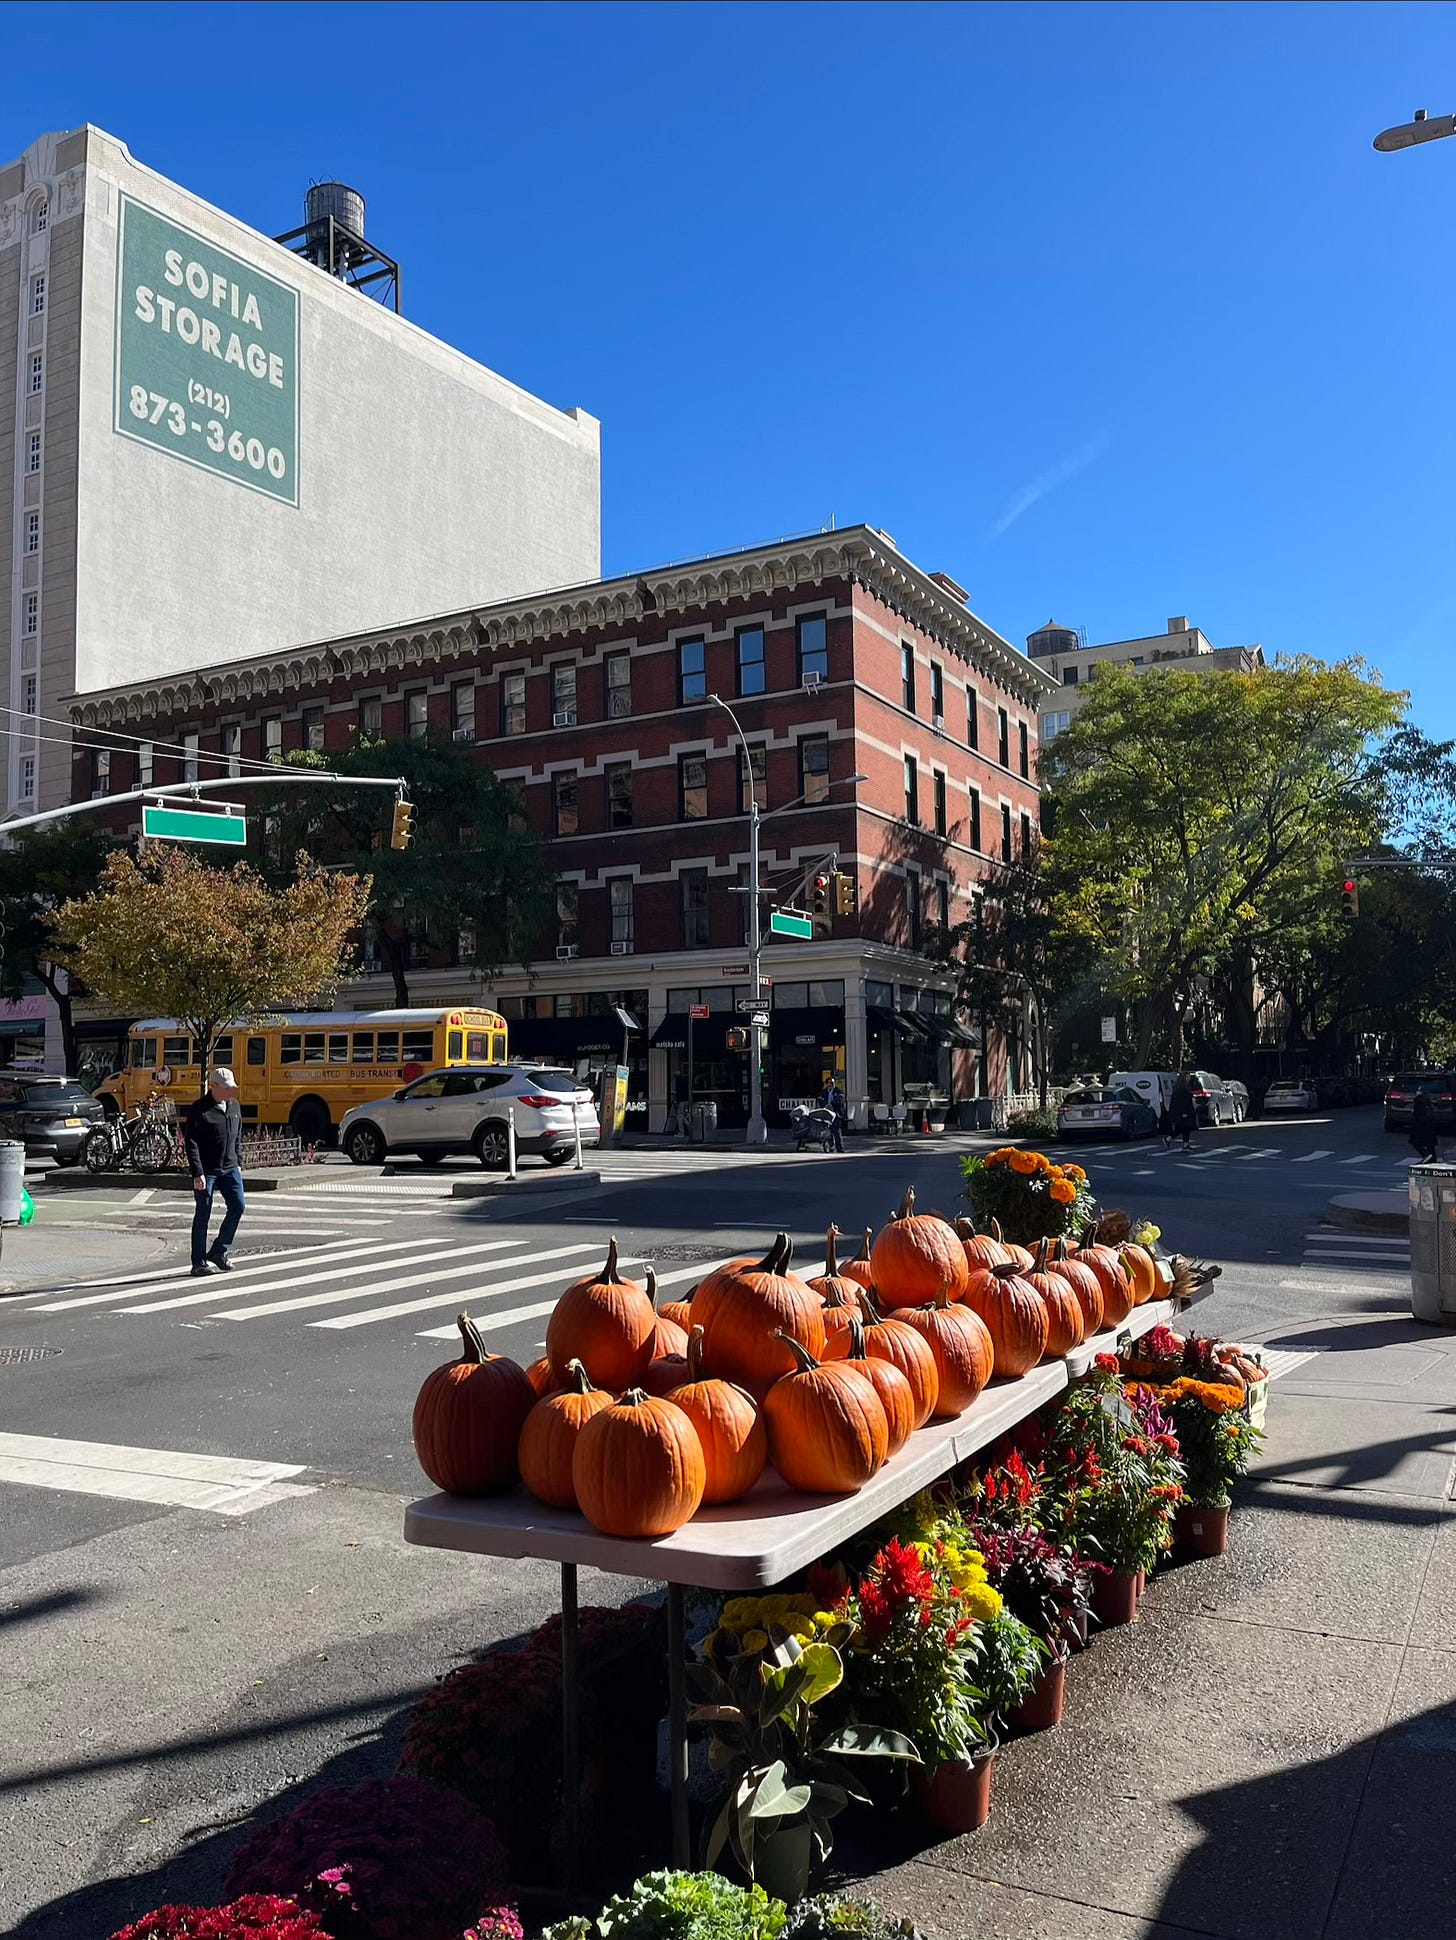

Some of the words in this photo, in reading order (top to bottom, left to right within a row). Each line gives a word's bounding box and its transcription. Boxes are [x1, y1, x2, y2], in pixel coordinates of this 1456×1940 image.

[163, 249, 263, 331] SOFIA
[135, 285, 284, 389] STORAGE
[129, 384, 286, 479] 873-3600
[187, 377, 230, 420] (212)
[350, 1069, 365, 1079] BUS
[367, 1068, 400, 1078] TRANSI
